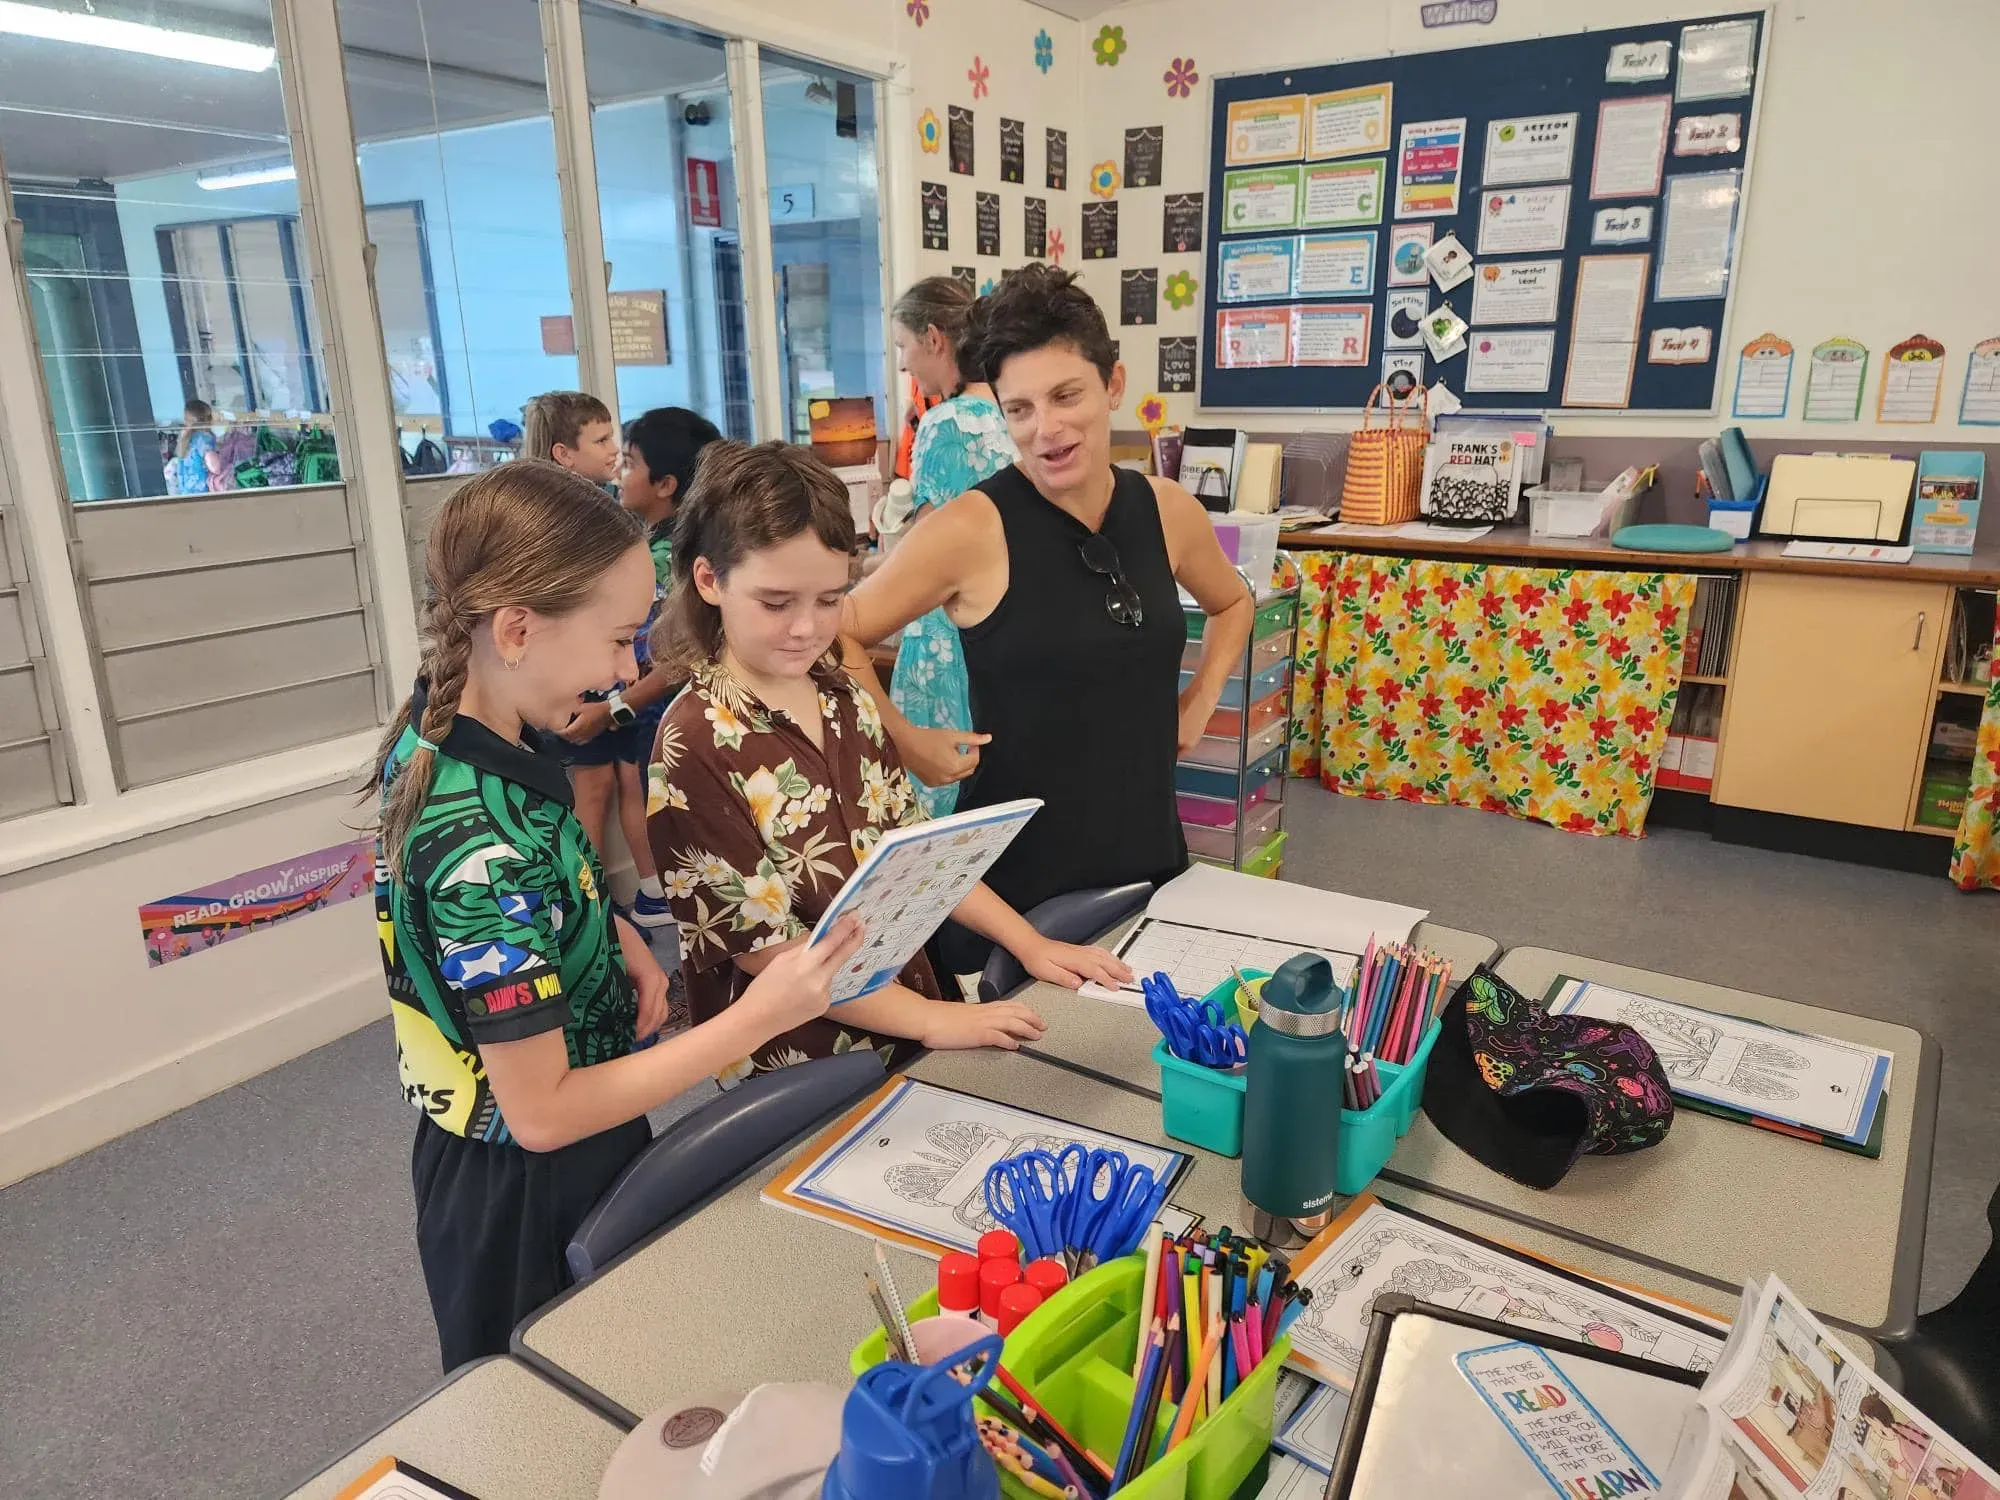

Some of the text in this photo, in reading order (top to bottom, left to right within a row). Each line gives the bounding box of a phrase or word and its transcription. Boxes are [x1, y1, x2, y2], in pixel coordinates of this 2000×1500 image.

[1523, 121, 1568, 133] ACTION
[783, 193, 794, 215] 5
[1233, 201, 1246, 221] C
[1357, 192, 1372, 213] C
[1228, 272, 1240, 290] E
[1350, 266, 1363, 284] E
[1342, 336, 1358, 354] R
[1165, 360, 1190, 370] Love
[1163, 371, 1191, 382] Dream
[1451, 443, 1498, 455] FRANK'S
[1449, 455, 1497, 467] RED HAT
[173, 901, 229, 929] READ,
[294, 861, 349, 888] INSPIRE
[401, 1084, 455, 1115] tts
[1505, 1360, 1538, 1374] MORE
[1488, 1370, 1545, 1388] THAT YOU
[1502, 1384, 1567, 1415] READ
[1525, 1411, 1583, 1431] THE MORE
[1528, 1421, 1597, 1442] THINGS YOU
[1537, 1431, 1600, 1452] WILL KNOW
[1548, 1441, 1608, 1462] THE MORE
[1559, 1452, 1617, 1472] THAT YOU
[1563, 1467, 1650, 1500] LEARN
